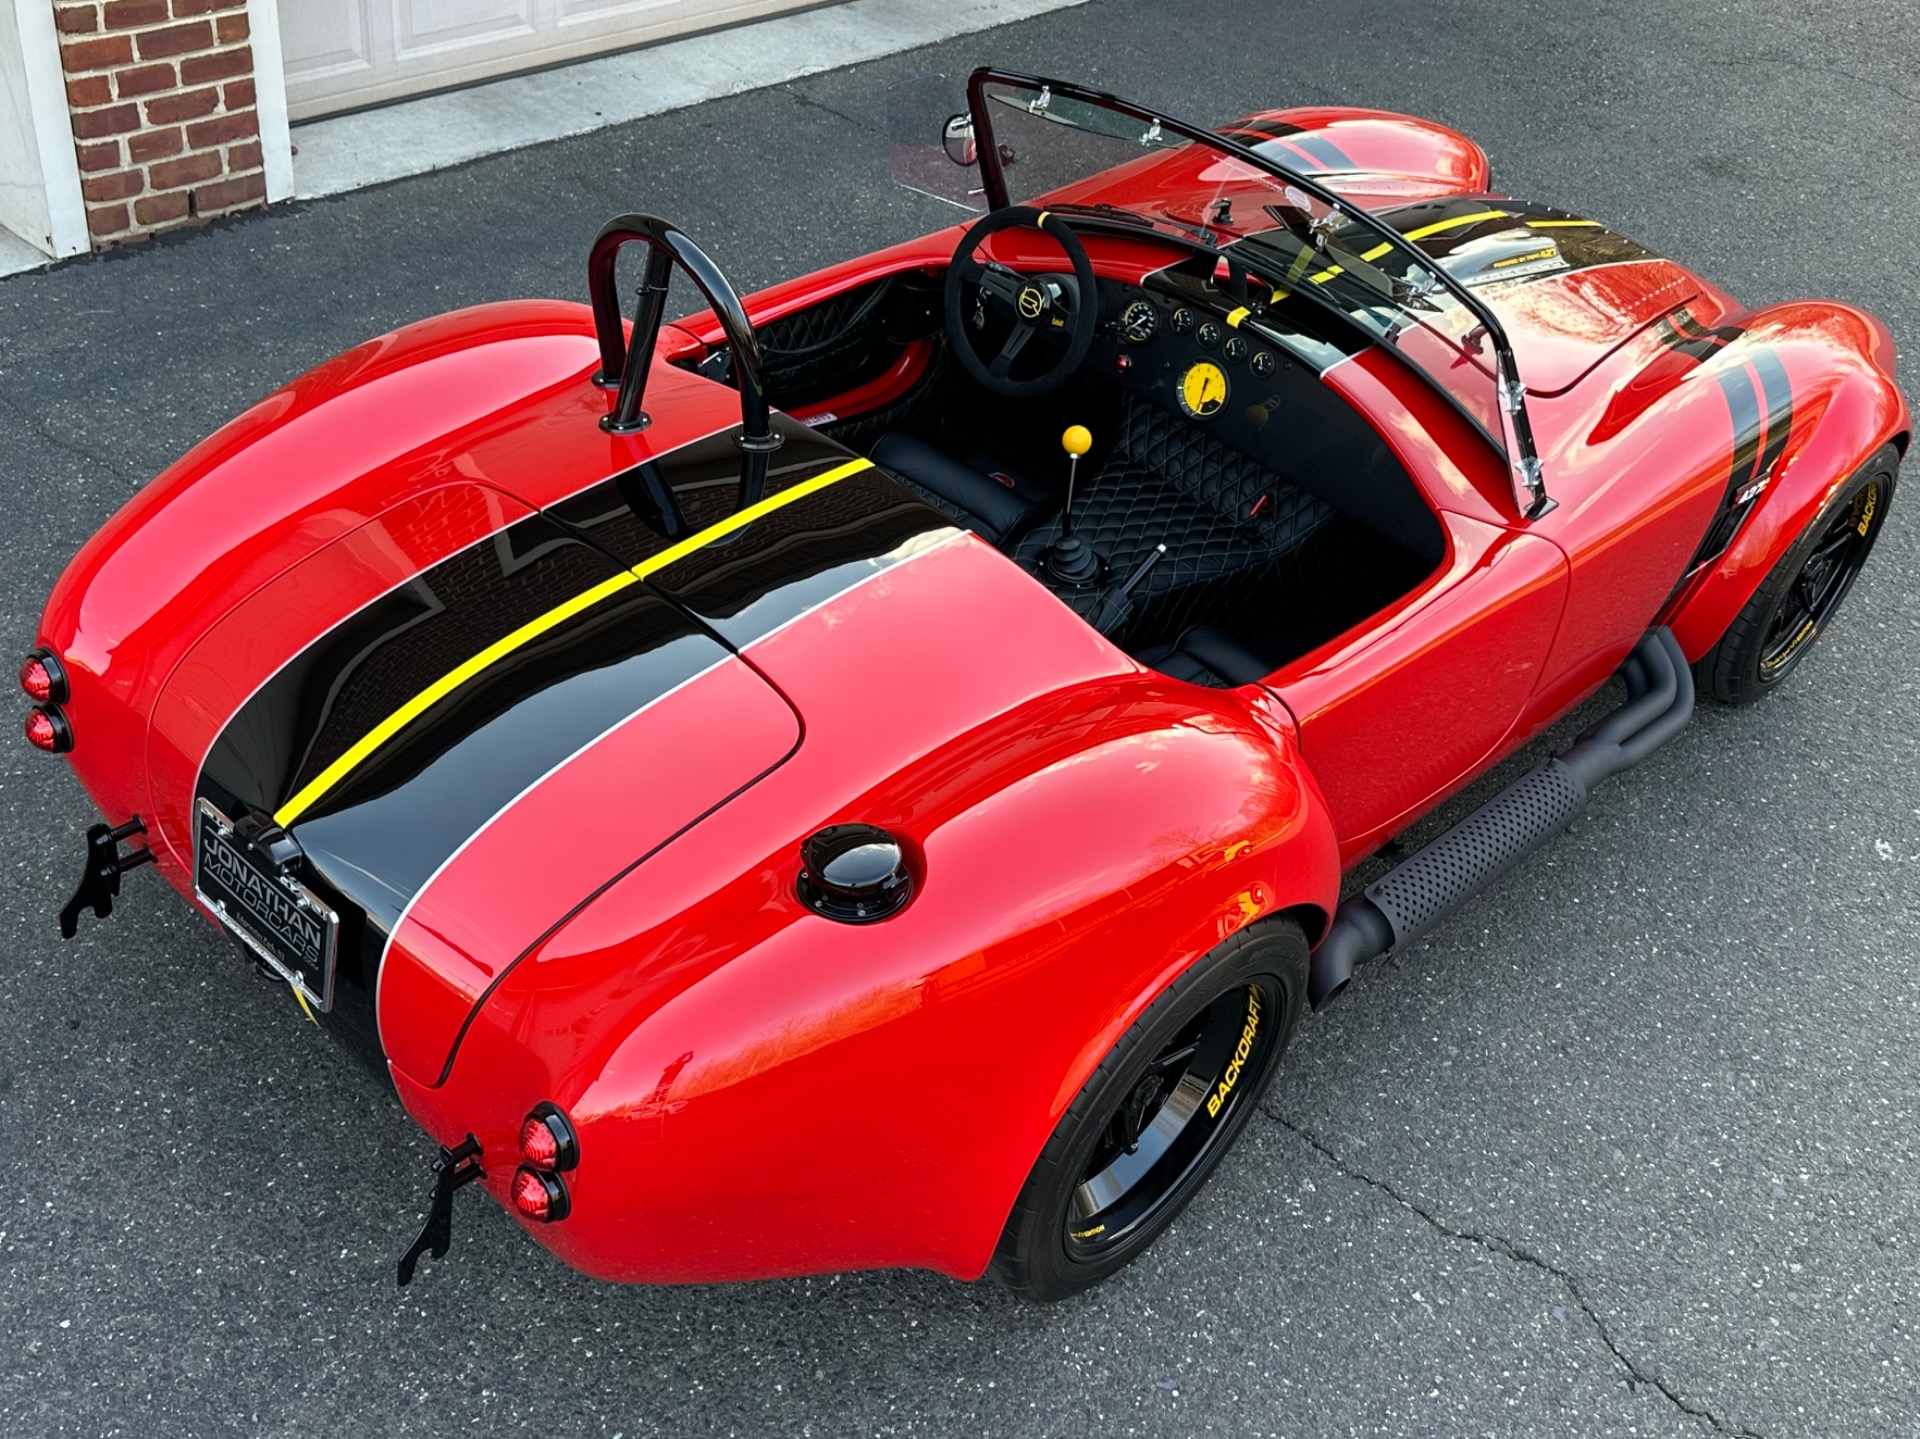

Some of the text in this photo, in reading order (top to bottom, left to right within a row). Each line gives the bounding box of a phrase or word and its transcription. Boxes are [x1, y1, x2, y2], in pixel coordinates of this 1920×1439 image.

[203, 853, 319, 963] MOTORCARS
[204, 837, 321, 950] JONATHAN
[1206, 994, 1261, 1118] BACKDRAFT
